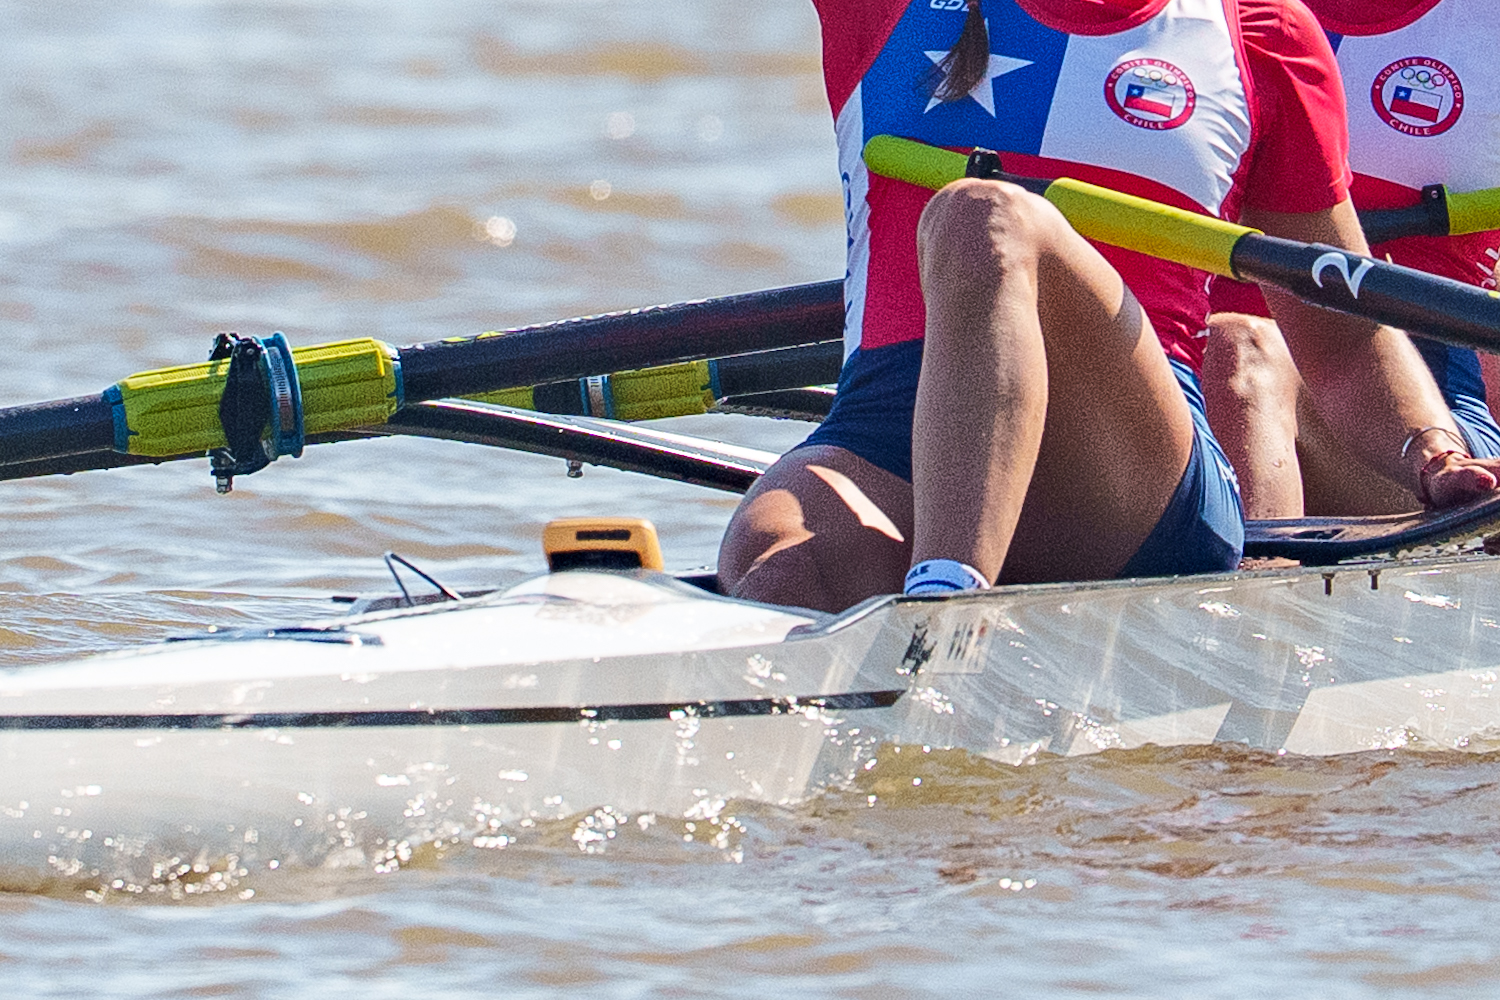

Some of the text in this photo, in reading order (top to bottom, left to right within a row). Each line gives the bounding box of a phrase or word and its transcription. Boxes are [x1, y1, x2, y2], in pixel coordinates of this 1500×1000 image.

[1154, 61, 1194, 98] OLIMPICO
[1380, 59, 1462, 99] COMITE OLIMPICO
[1124, 114, 1165, 129] CHILE
[1389, 119, 1431, 135] CHILE
[1312, 252, 1375, 299] 2
